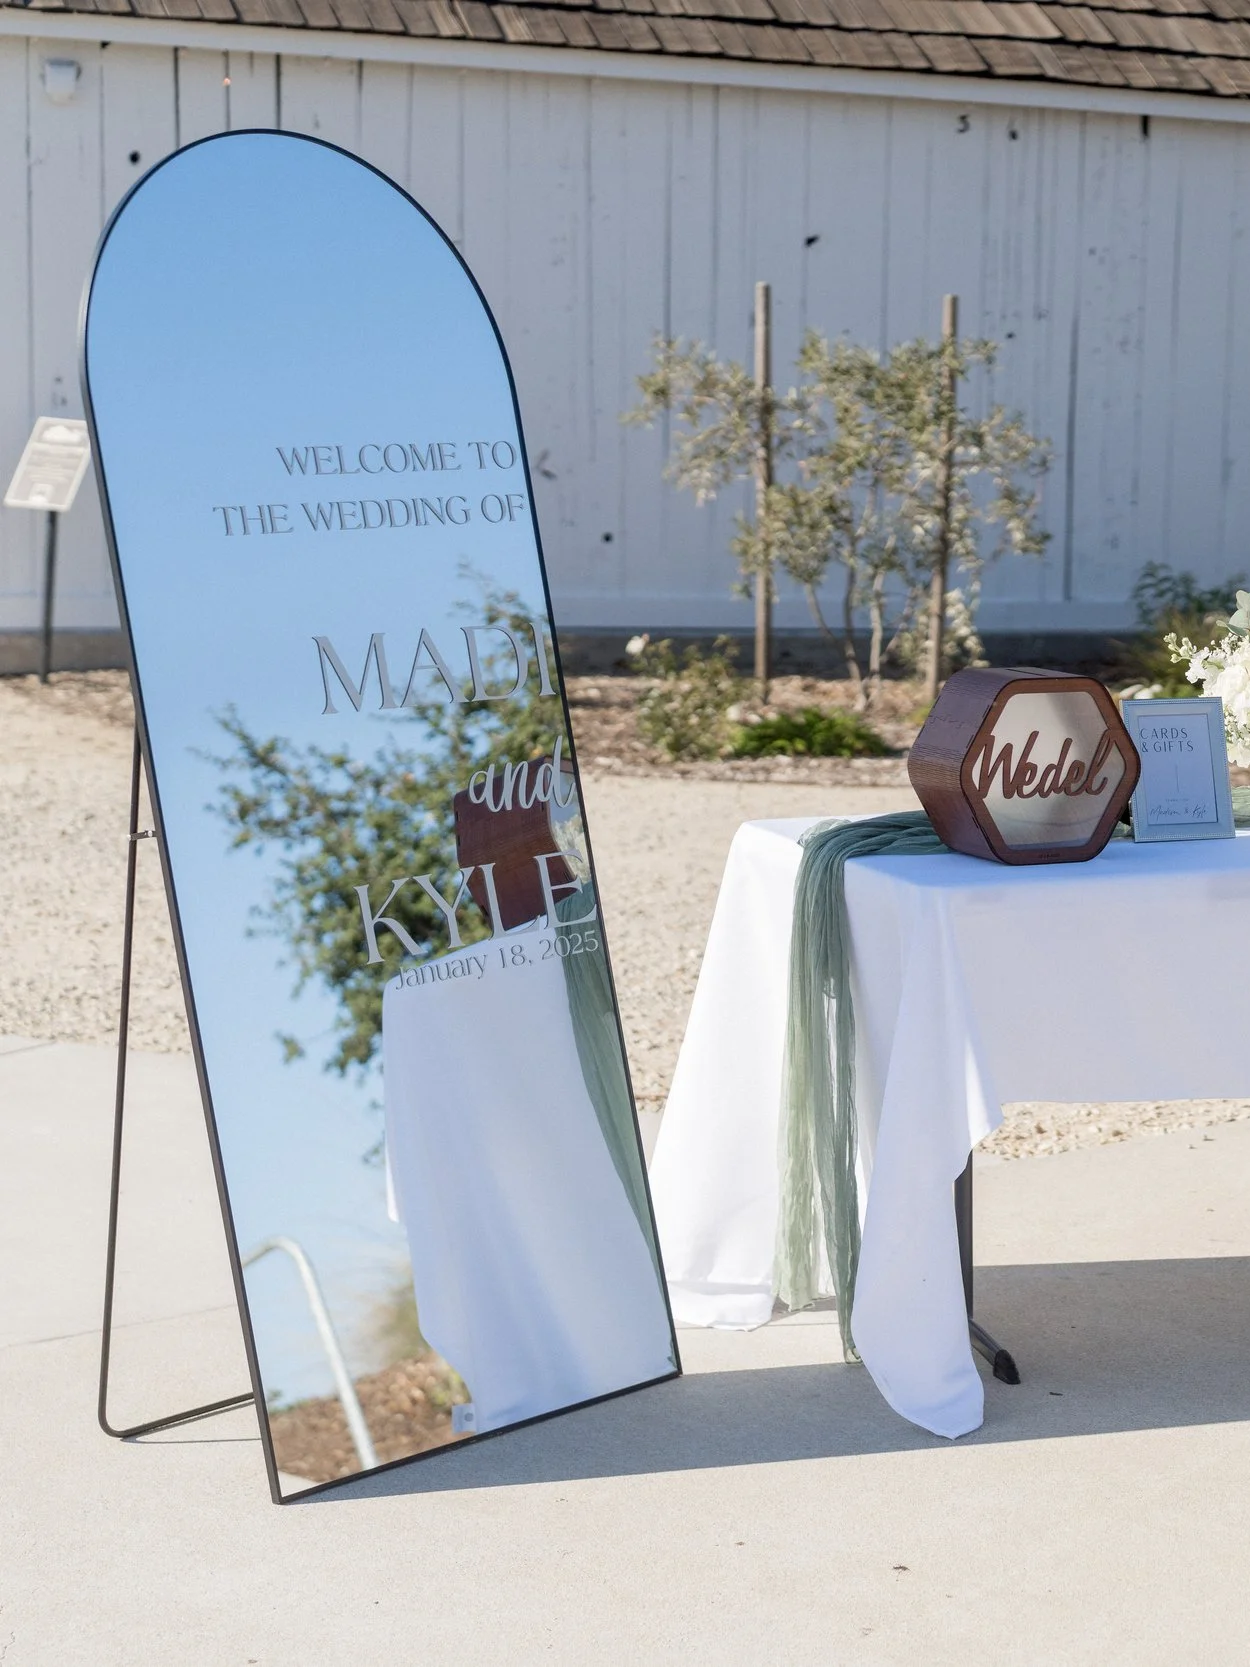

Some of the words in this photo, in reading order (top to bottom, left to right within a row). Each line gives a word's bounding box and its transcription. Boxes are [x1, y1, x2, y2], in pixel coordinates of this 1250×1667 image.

[275, 441, 462, 476] WELCOME
[467, 440, 517, 471] TO
[213, 502, 294, 537] THE
[301, 495, 472, 532] WEDDING
[481, 493, 527, 524] OF
[312, 622, 557, 715] MADI
[1140, 727, 1188, 739] CARDS
[1141, 741, 1149, 752] &
[1153, 741, 1194, 752] GIFTS
[468, 736, 575, 812] and
[978, 730, 1113, 800] Wedel
[353, 848, 598, 965] KYLE
[395, 951, 488, 990] January
[499, 946, 535, 969] 18,
[538, 930, 599, 961] 2025
